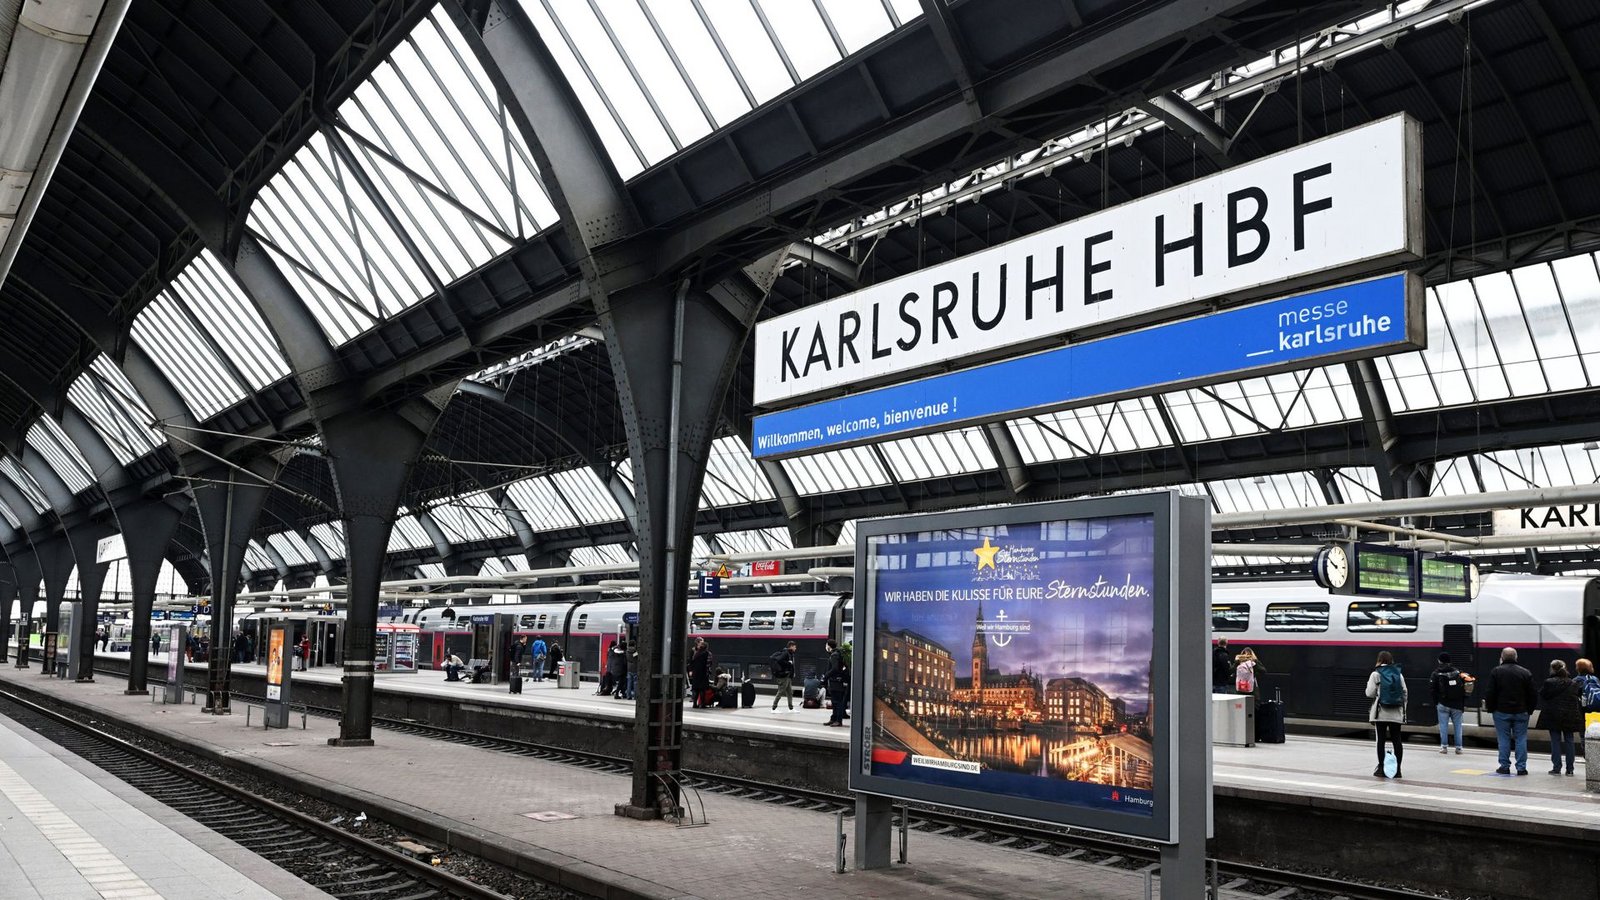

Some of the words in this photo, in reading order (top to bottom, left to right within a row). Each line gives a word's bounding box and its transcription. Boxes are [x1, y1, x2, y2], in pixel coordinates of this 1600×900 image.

[781, 230, 1113, 383] KARLSRUHE
[1155, 162, 1333, 288] HBF
[1279, 300, 1348, 328] messe
[1279, 315, 1391, 351] karlsruhe
[758, 427, 824, 449] Willkommen,
[827, 415, 880, 437] welcome,
[884, 401, 949, 426] bienvenue
[952, 397, 957, 413] !
[704, 577, 713, 594] E
[885, 590, 902, 602] WIR
[903, 589, 934, 602] HABEN
[935, 589, 950, 601] DIE
[952, 588, 990, 600] KULISSE
[993, 586, 1013, 600] FÜR
[1016, 587, 1043, 600] EURE
[1045, 573, 1150, 600] Sternstunden.
[913, 757, 979, 772] WEILWIRHAMBURGSIND.DE
[1124, 794, 1154, 808] Hamburg
